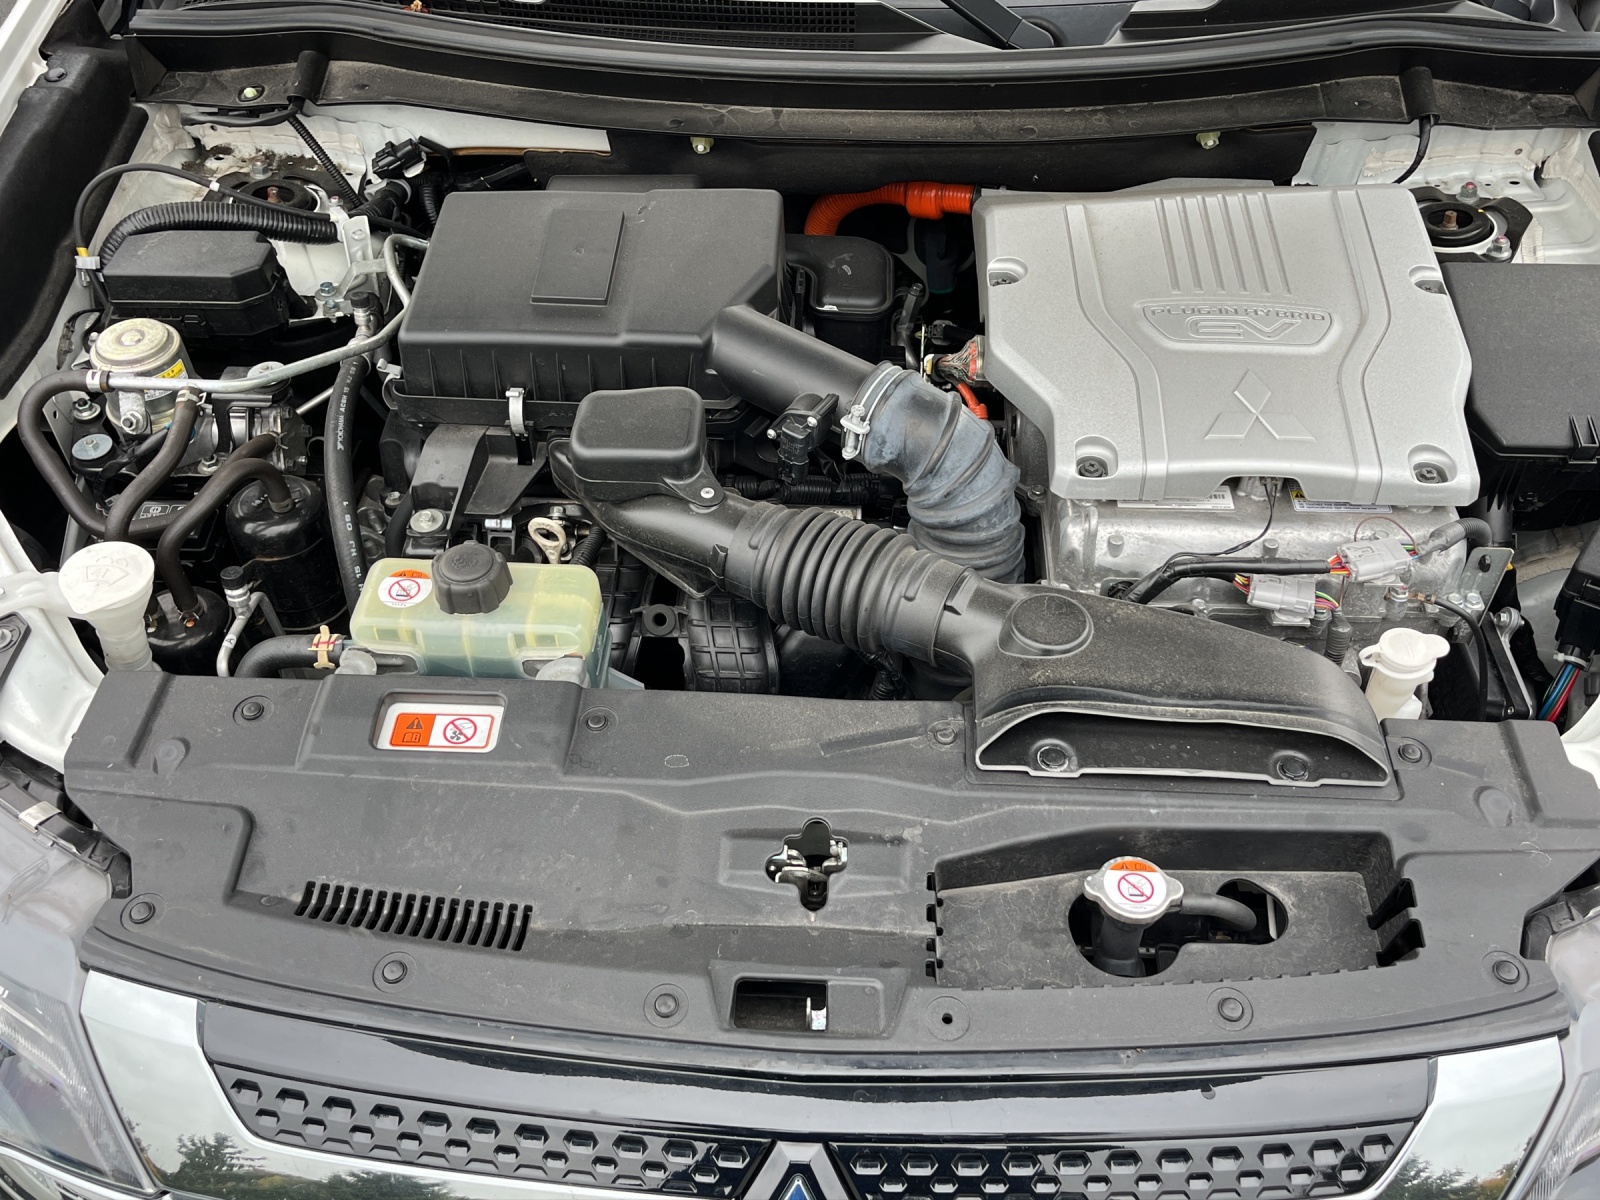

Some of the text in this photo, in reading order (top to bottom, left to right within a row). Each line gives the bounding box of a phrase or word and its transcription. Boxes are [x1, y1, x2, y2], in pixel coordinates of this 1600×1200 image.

[1150, 305, 1326, 321] PLUG-IN HYBRID
[1185, 315, 1302, 340] EV
[349, 540, 358, 557] HJ
[354, 565, 362, 578] 15
